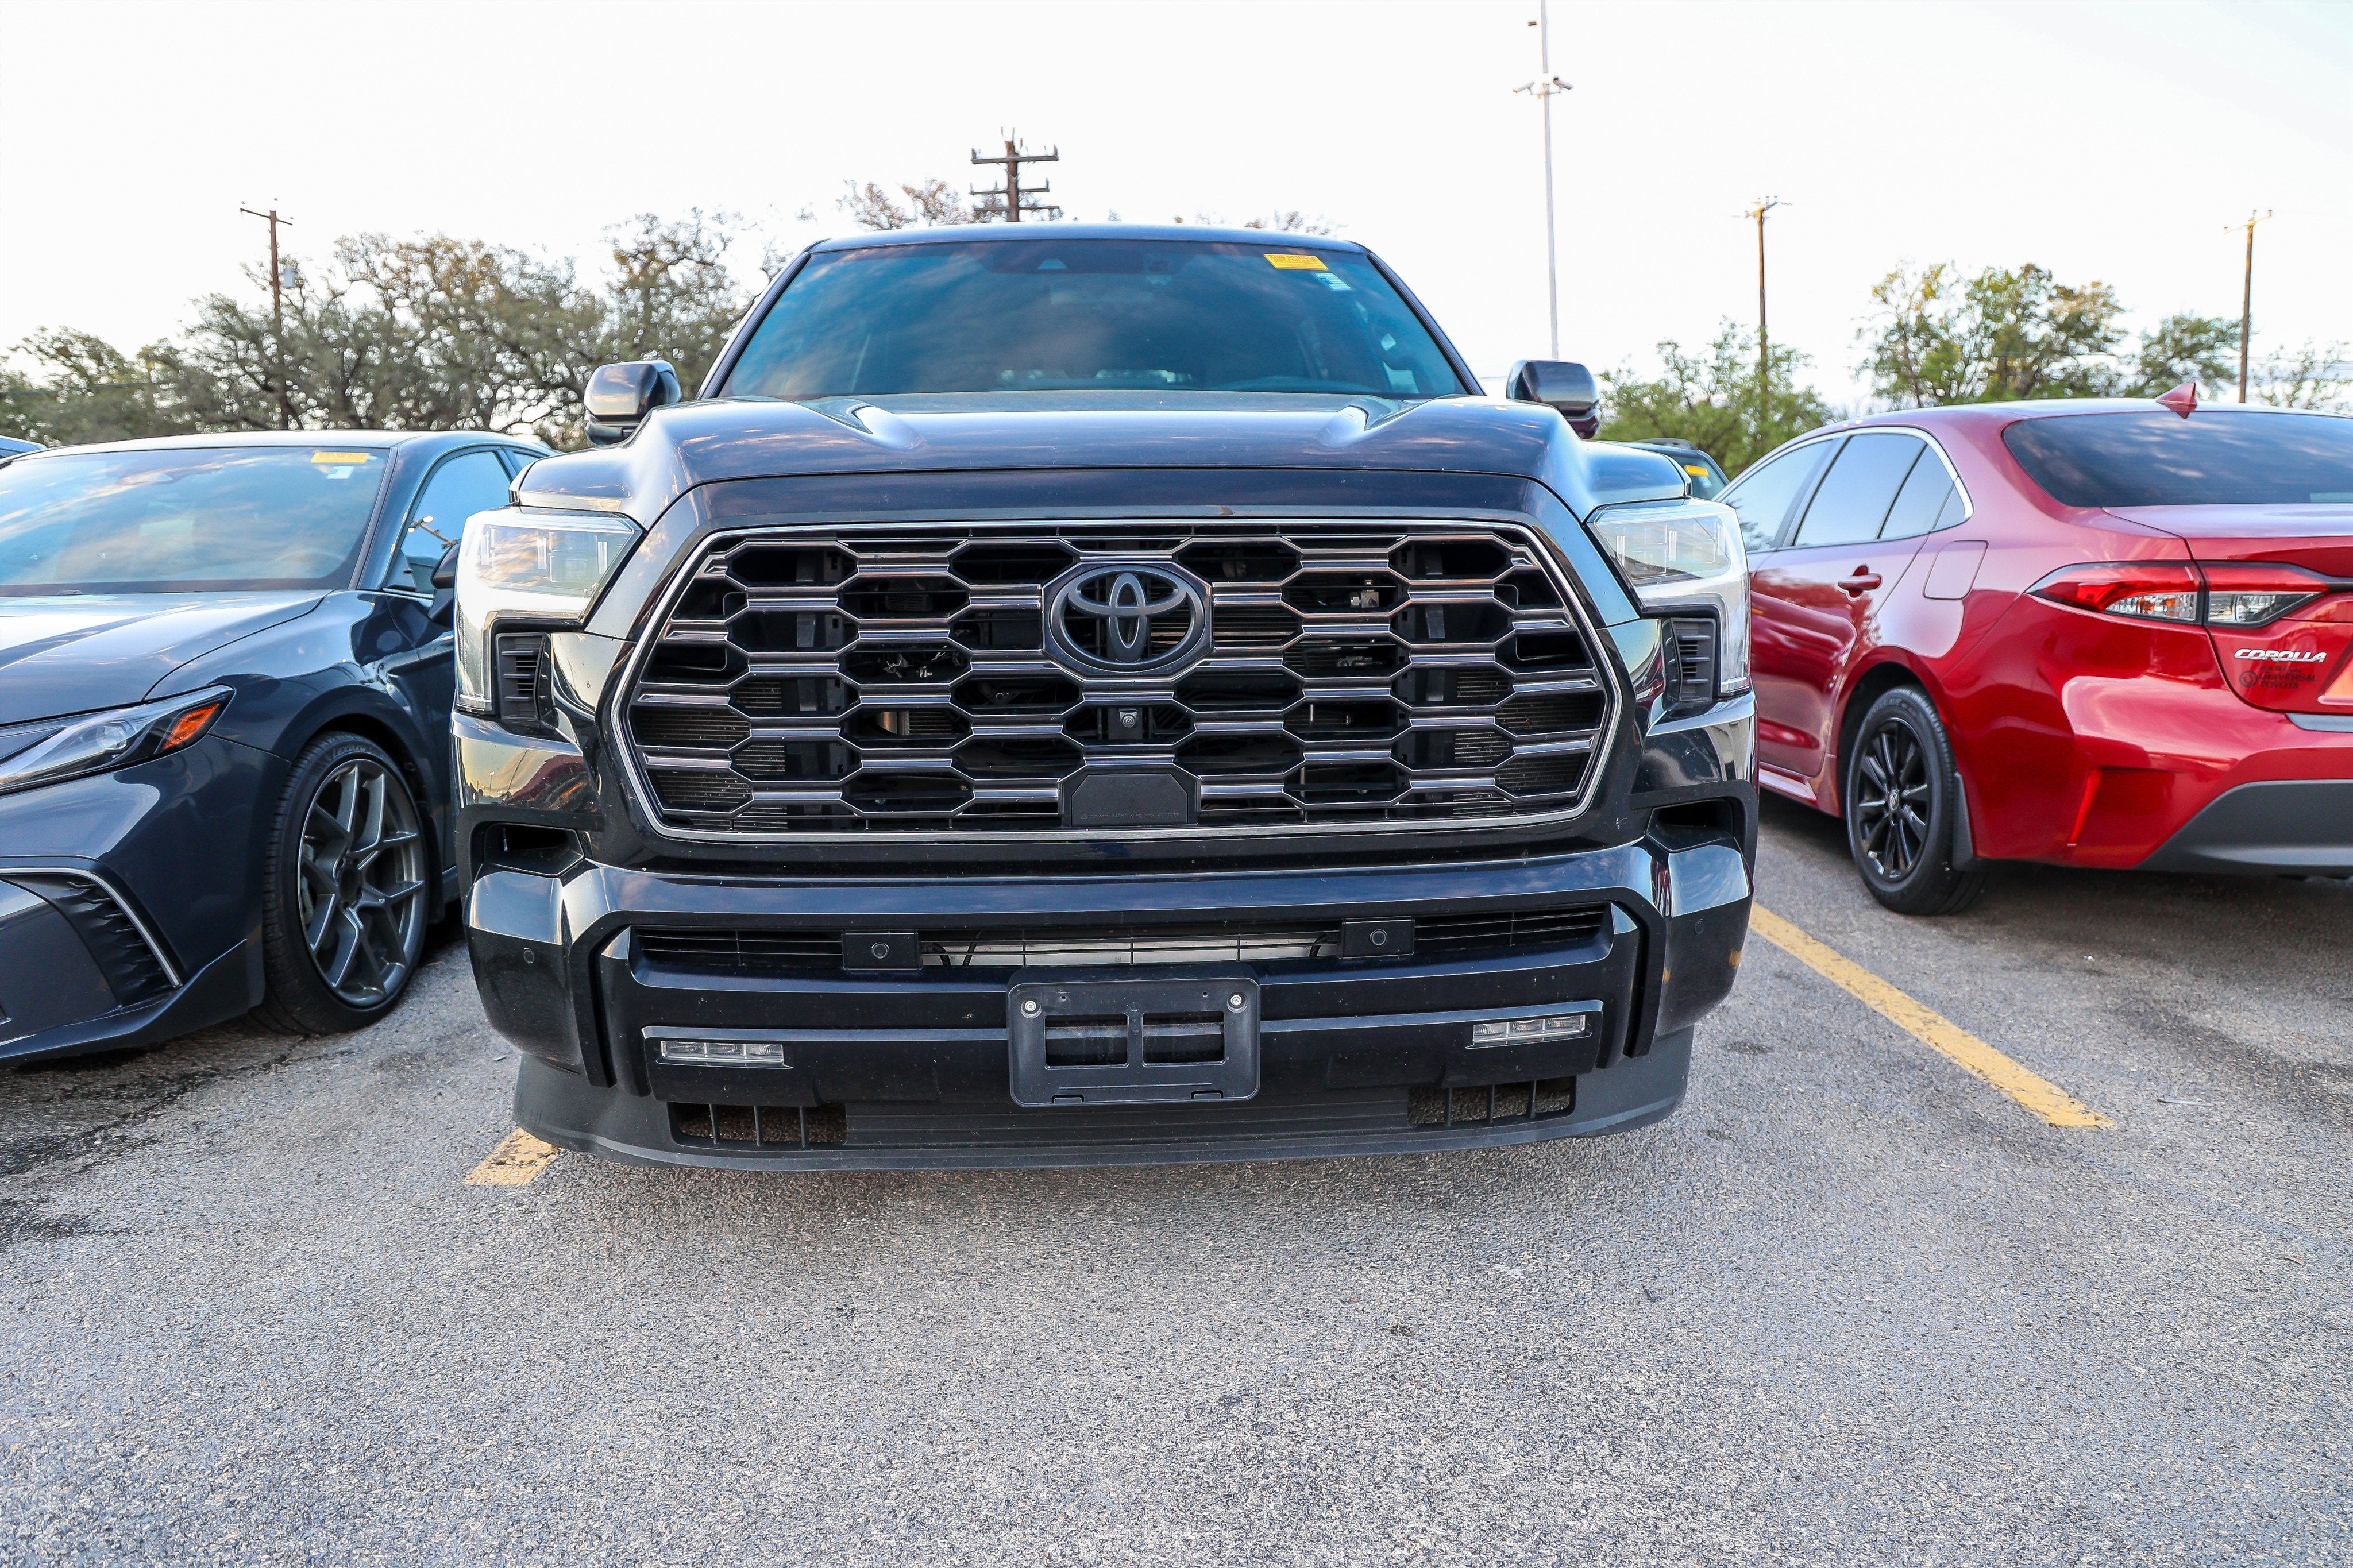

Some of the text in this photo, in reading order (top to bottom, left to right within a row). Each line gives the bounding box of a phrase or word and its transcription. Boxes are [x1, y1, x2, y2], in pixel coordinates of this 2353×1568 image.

[2234, 648, 2327, 663] COROLLA
[2260, 673, 2316, 682] UNIVERSAL
[2261, 681, 2300, 689] TOYOTA
